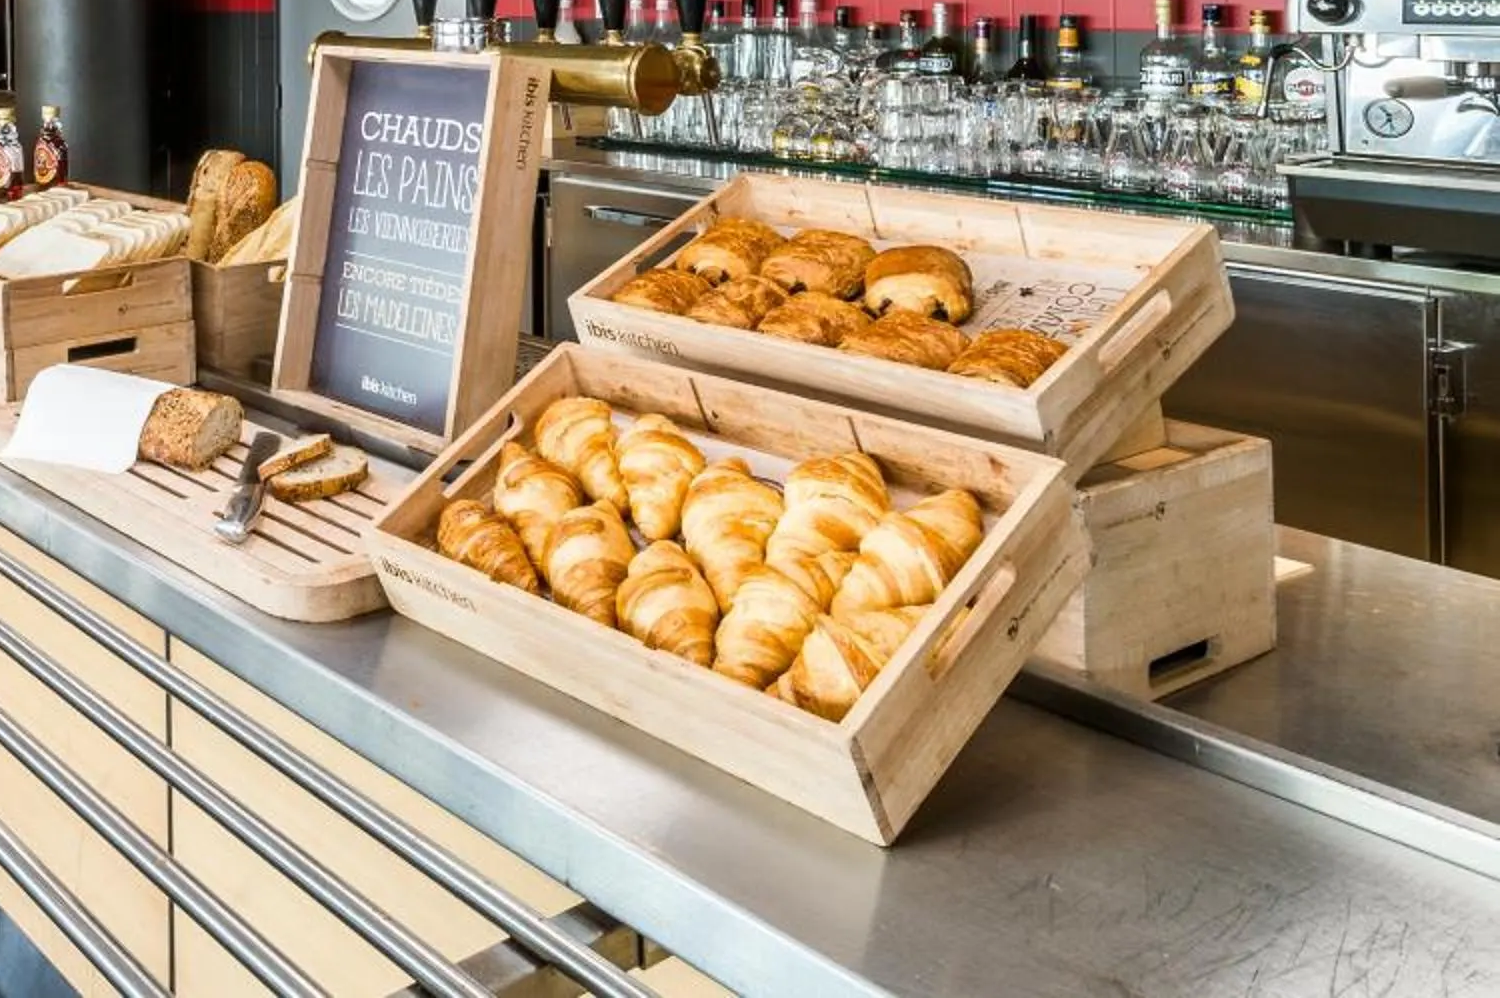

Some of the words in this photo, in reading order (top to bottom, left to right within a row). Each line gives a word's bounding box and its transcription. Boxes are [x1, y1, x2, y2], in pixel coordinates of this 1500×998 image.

[361, 111, 483, 153] CHAUDS
[353, 149, 393, 199] LES
[398, 154, 478, 214] PAINS
[348, 206, 370, 235] LES
[342, 260, 407, 292] ENCORE
[337, 286, 361, 319] LES
[363, 294, 457, 346] MADELEINES
[585, 319, 617, 342] ibis
